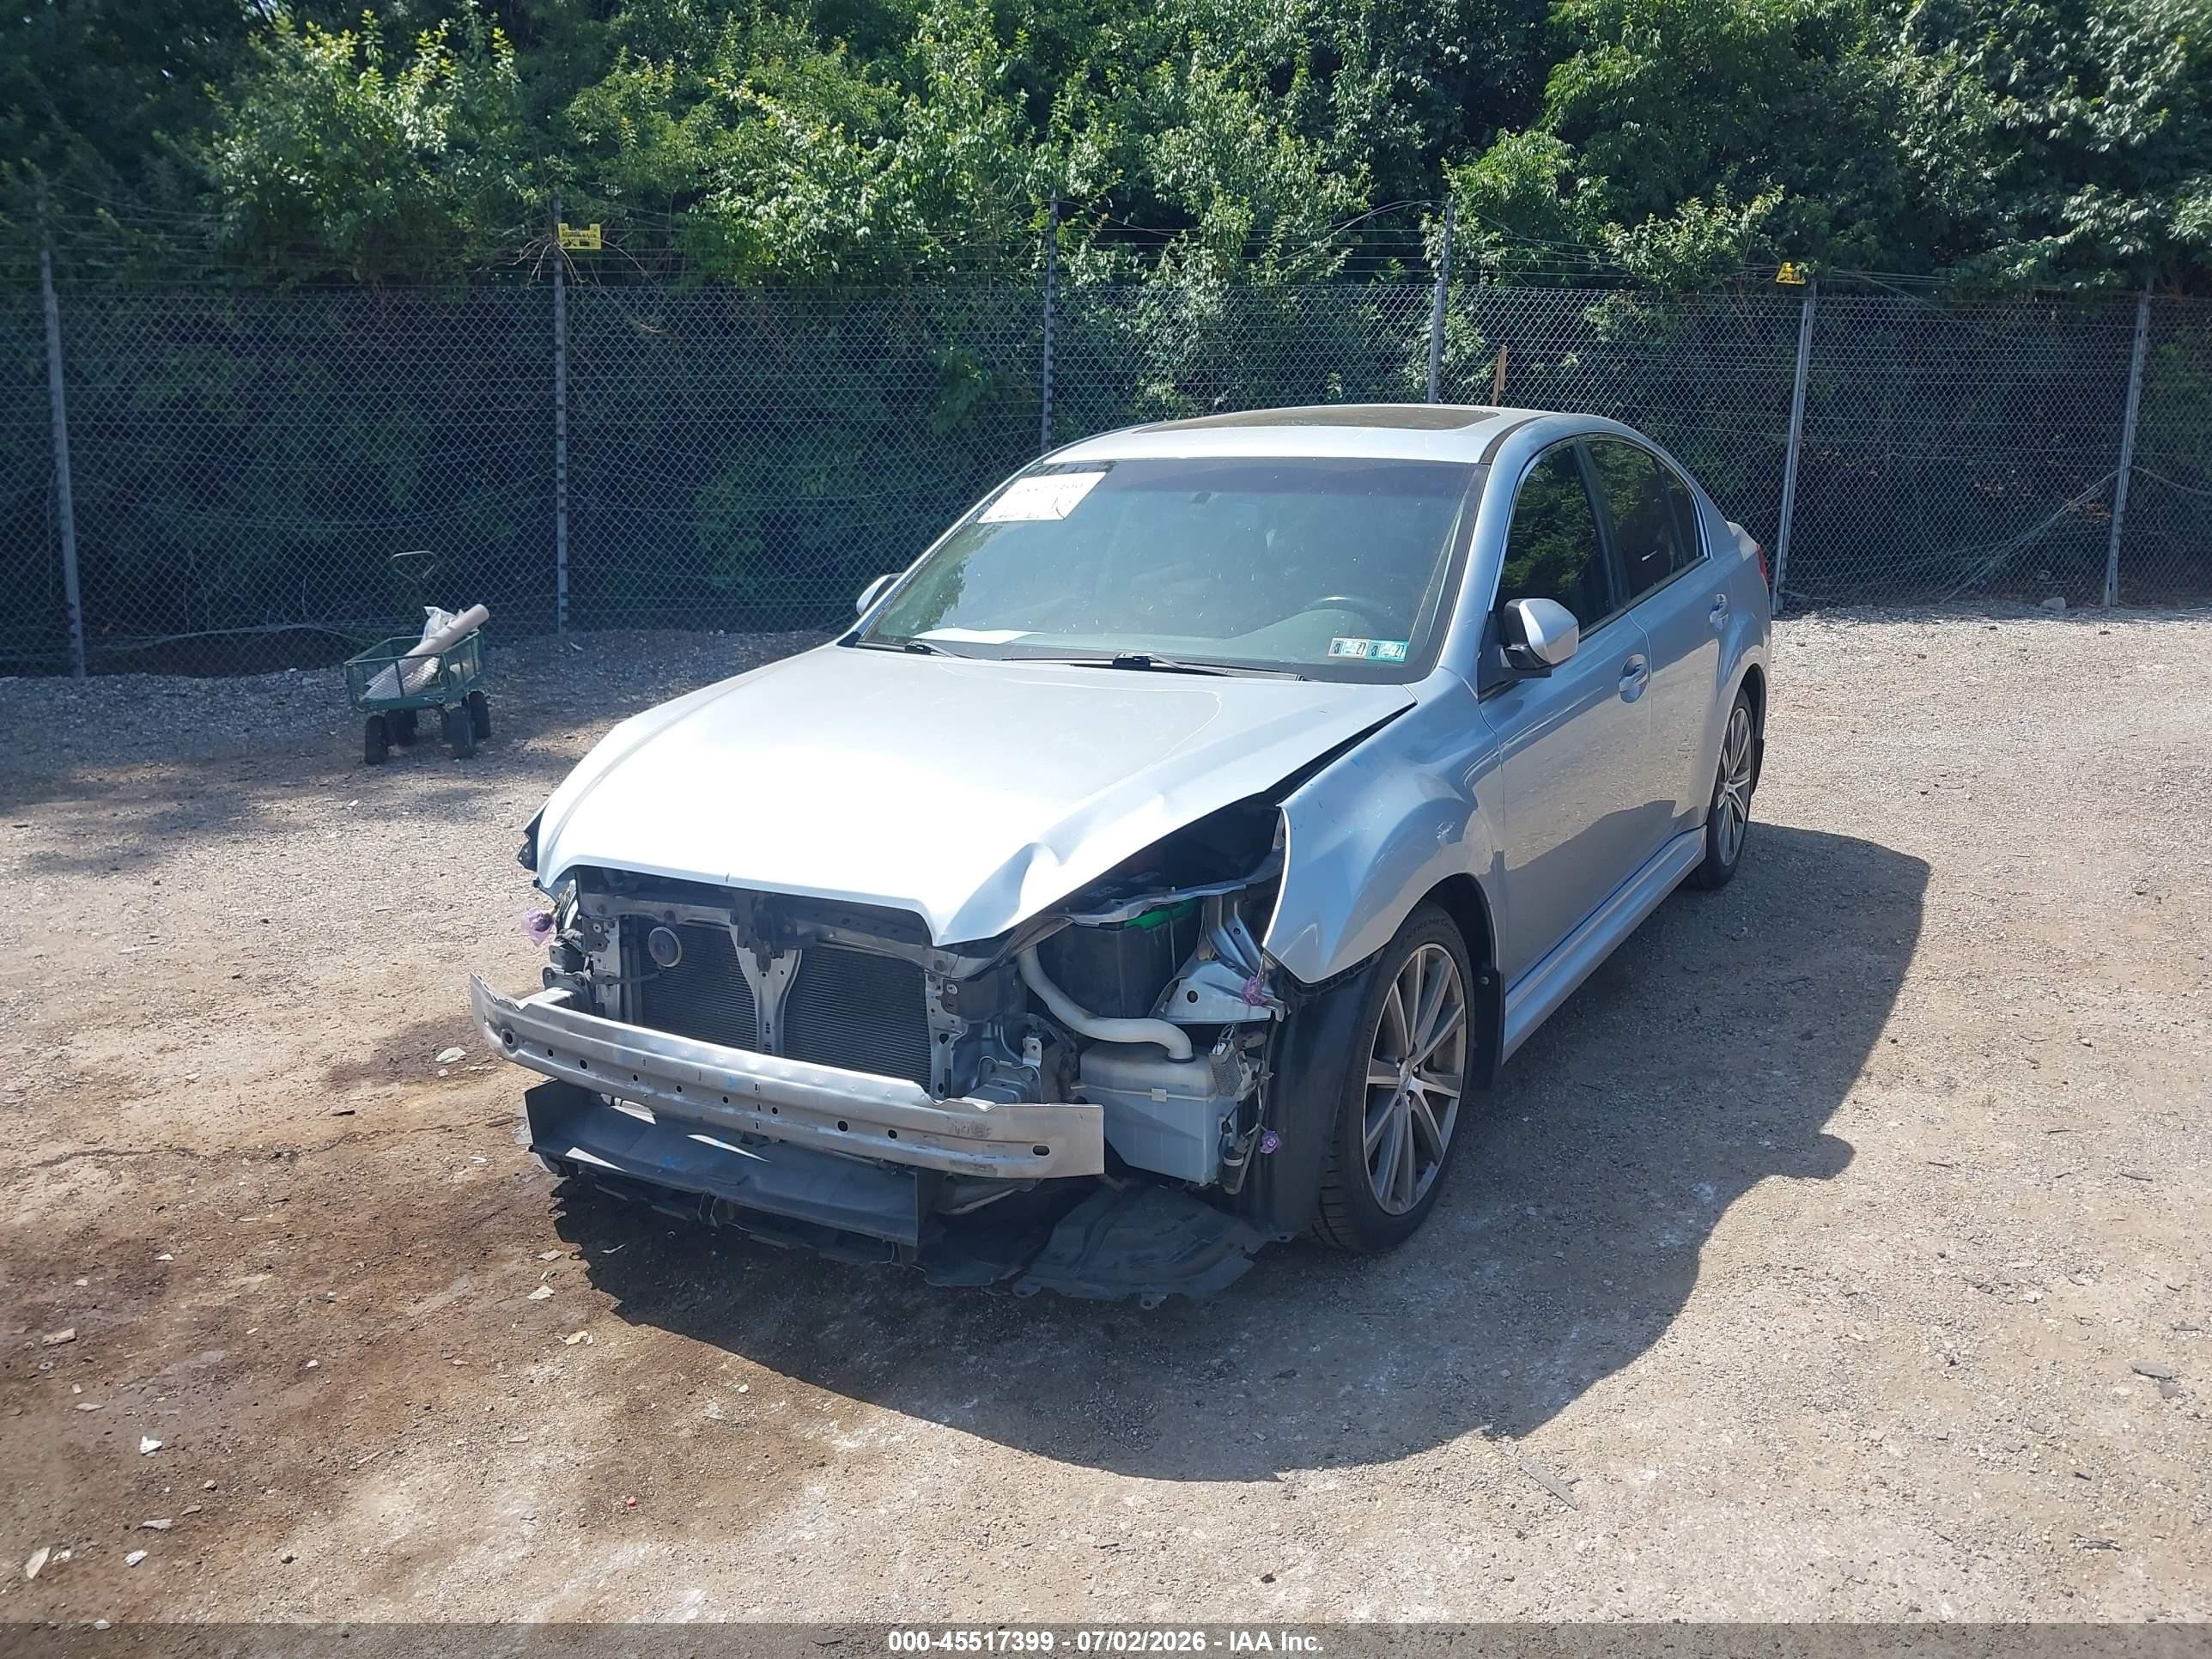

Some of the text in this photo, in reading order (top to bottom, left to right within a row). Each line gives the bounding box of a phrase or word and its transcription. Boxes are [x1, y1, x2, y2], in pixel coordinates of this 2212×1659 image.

[1333, 642, 1341, 654] 3
[1356, 641, 1367, 656] 27
[1370, 645, 1379, 657] 3
[1394, 643, 1406, 659] 27
